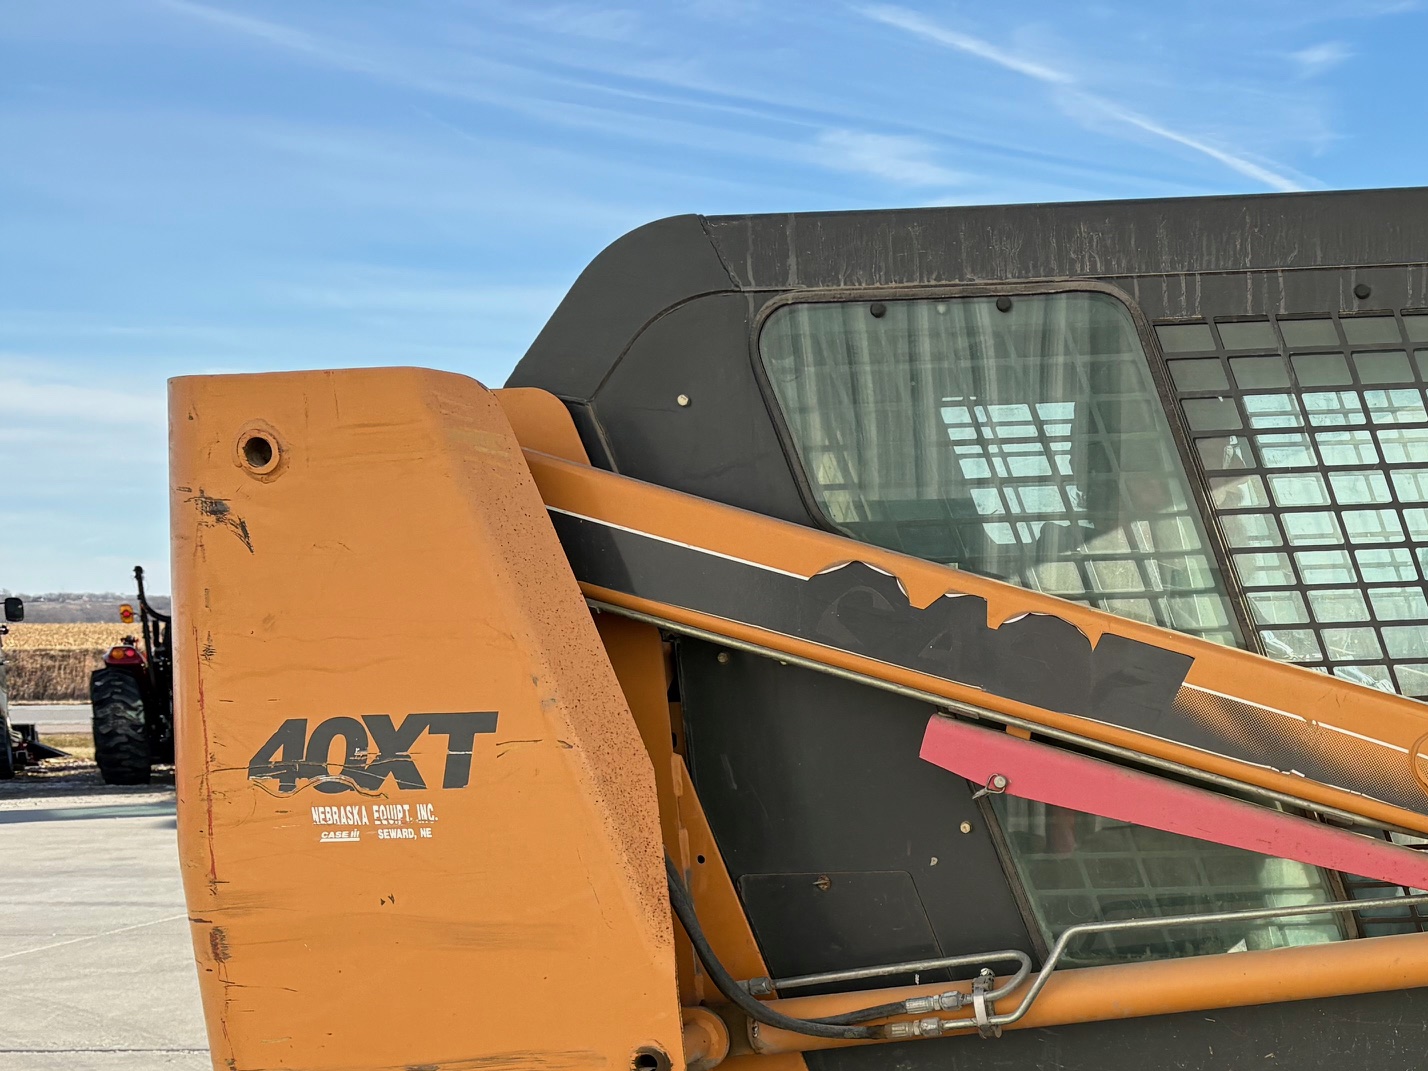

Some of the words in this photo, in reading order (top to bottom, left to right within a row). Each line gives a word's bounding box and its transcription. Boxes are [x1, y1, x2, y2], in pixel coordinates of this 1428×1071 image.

[247, 711, 499, 794] 40XT
[312, 805, 369, 825] NEBRASKA
[416, 803, 438, 823] INC.
[321, 830, 349, 839] CASE
[378, 829, 417, 840] SEWARD,
[420, 828, 432, 838] NE
